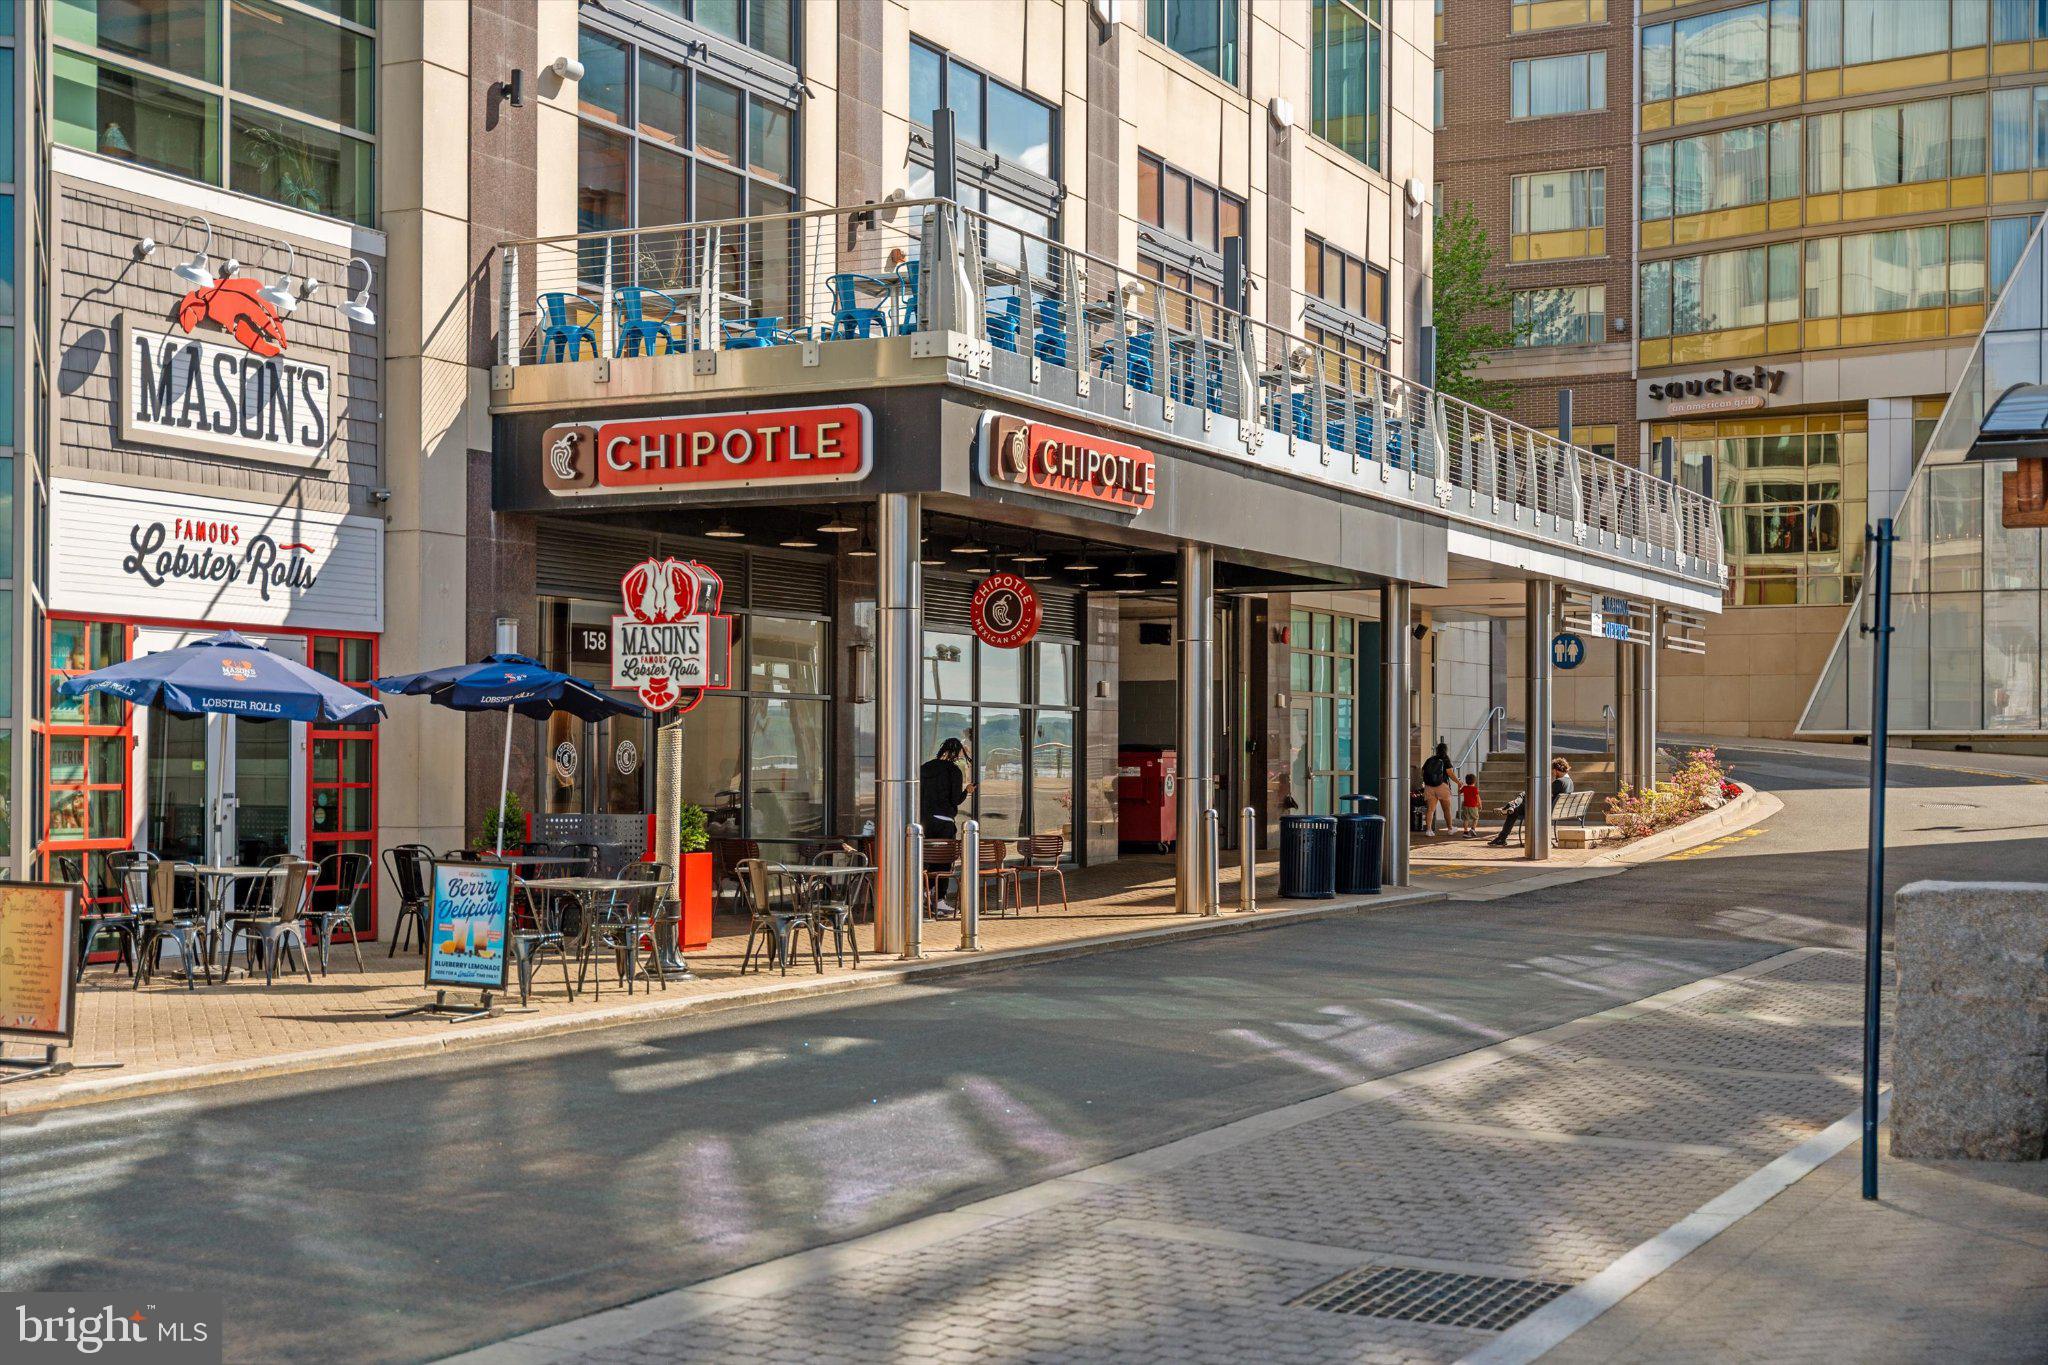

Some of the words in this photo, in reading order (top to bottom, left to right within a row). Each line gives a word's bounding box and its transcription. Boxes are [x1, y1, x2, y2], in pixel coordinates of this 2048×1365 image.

[135, 336, 325, 448] MASON'S
[1686, 400, 1731, 411] american
[1734, 397, 1755, 408] grill
[606, 422, 843, 471] CHIPOTLE
[1042, 439, 1156, 495] CHIPOTLE
[175, 517, 240, 546] FAMOUS
[123, 522, 240, 588] Lobster
[246, 534, 317, 602] Rolls
[974, 576, 1033, 606] CHIPOTLE
[582, 630, 607, 650] 158
[621, 625, 700, 656] MASON'S
[975, 618, 1009, 643] MEXICAN
[1011, 617, 1031, 641] GRILL
[621, 657, 667, 681] Lobster
[668, 656, 700, 681] Rolls
[640, 655, 667, 664] FAMOUS
[202, 697, 247, 710] LOBSTER
[249, 701, 282, 713] ROLLS
[434, 960, 467, 969] BLUEBERRY
[468, 963, 501, 971] LEMONADE
